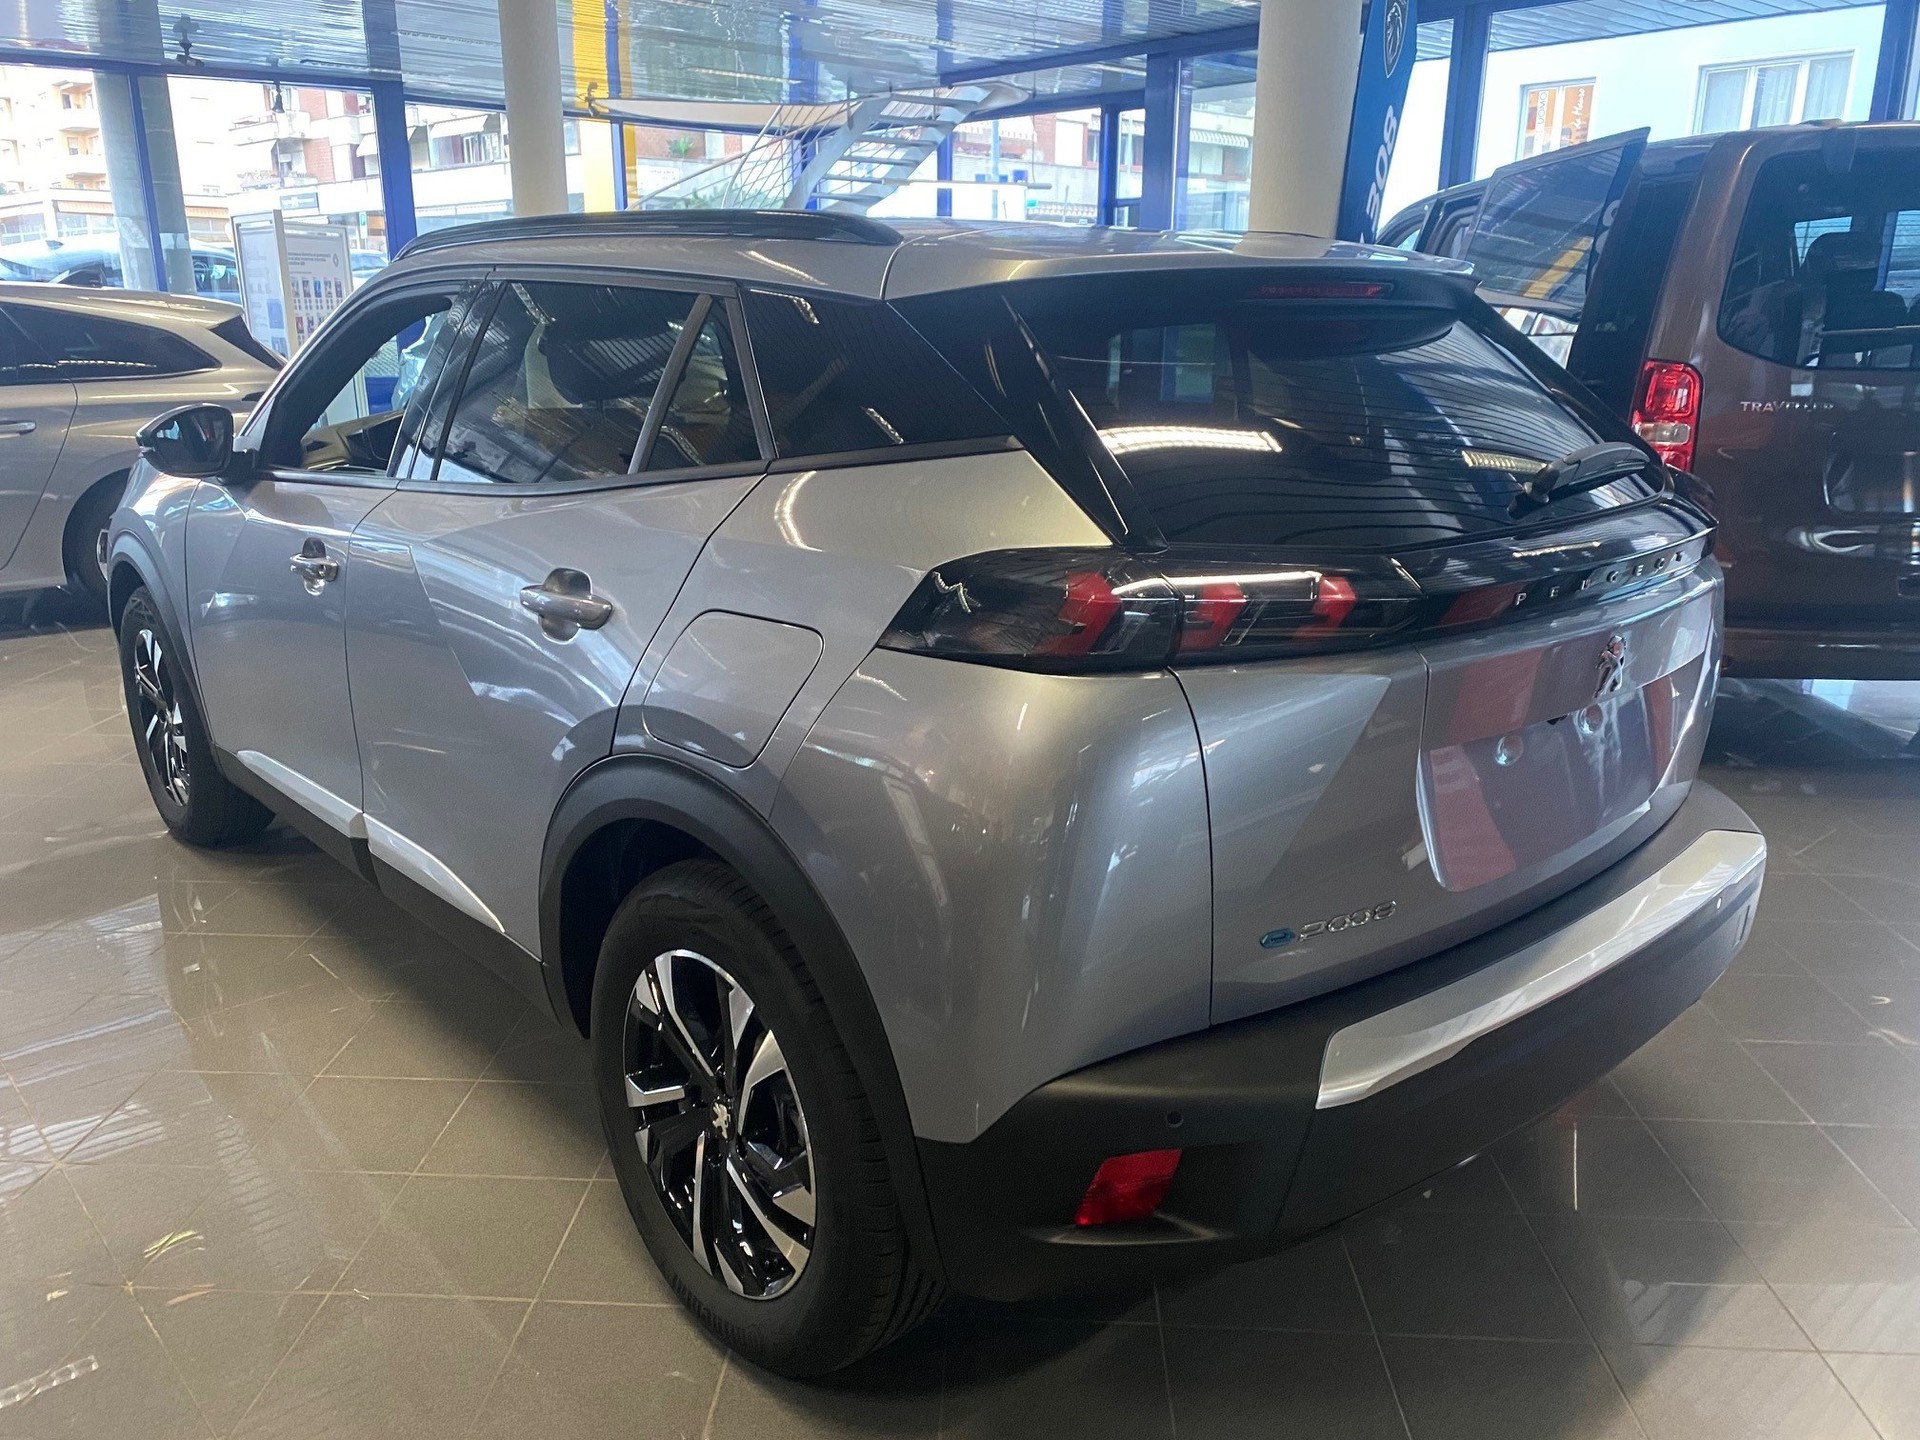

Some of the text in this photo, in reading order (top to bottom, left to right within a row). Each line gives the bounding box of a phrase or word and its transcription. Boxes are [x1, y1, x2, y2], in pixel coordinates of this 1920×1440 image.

[1537, 90, 1548, 125] UOMO
[1365, 105, 1398, 232] 308
[1740, 400, 1834, 412] TRAVE
[1514, 550, 1685, 606] PEUGEOT
